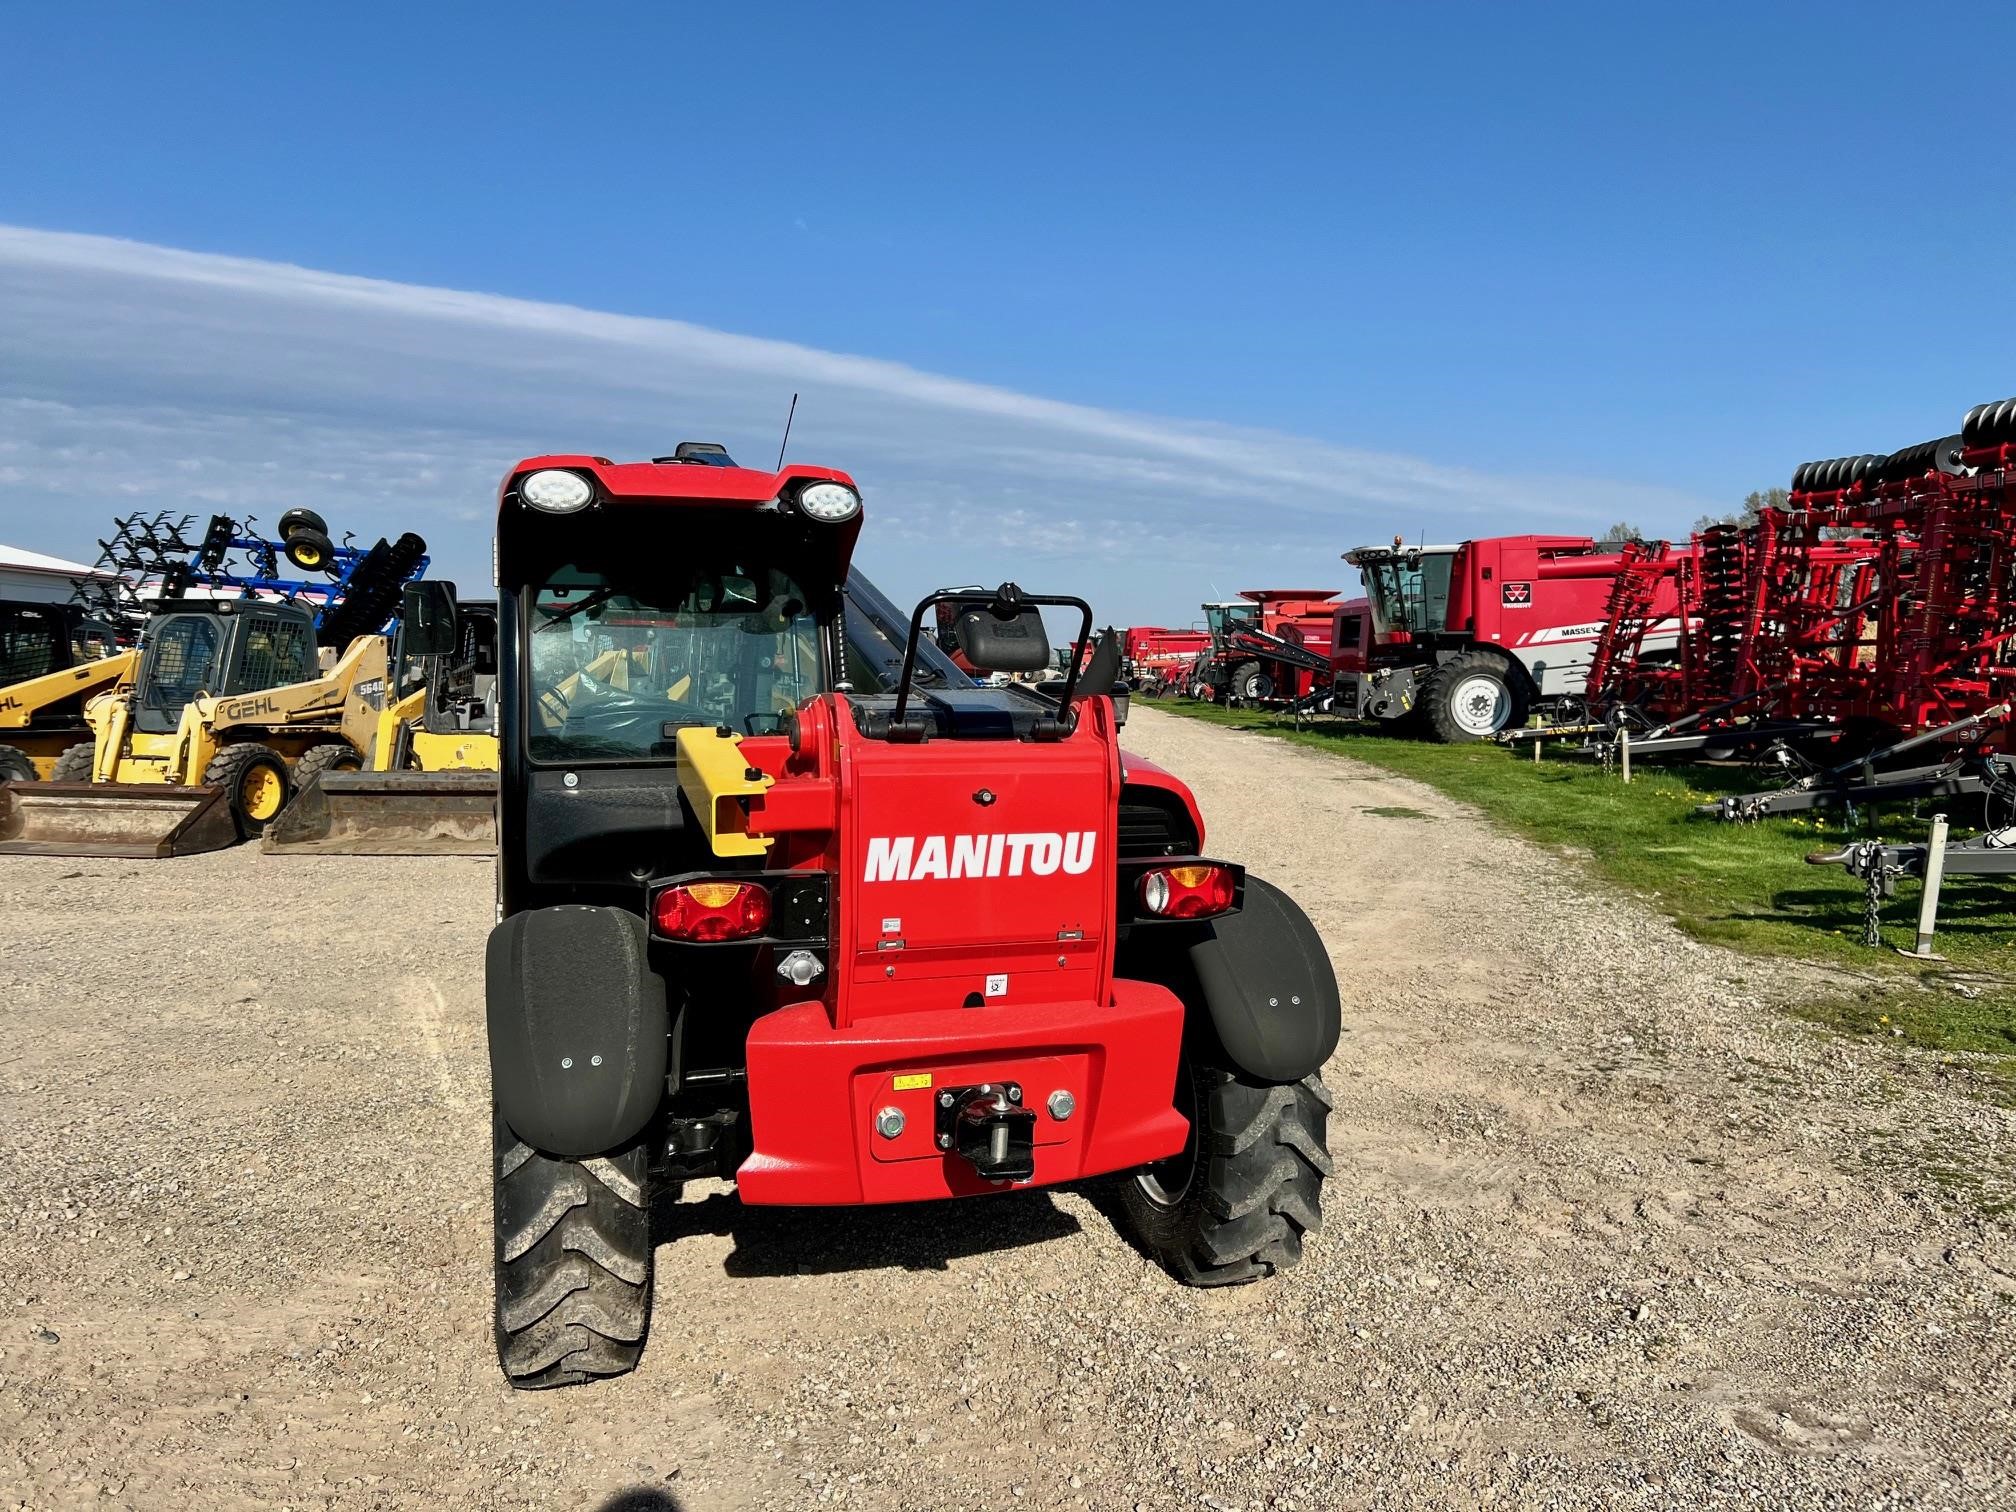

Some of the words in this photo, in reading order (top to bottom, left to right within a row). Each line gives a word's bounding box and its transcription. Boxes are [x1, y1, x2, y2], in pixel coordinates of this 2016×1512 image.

[1561, 626, 1597, 637] MASSEY
[360, 681, 384, 695] 5640
[0, 695, 24, 713] HL
[226, 696, 280, 721] GEHL
[863, 831, 1097, 883] MANITOU
